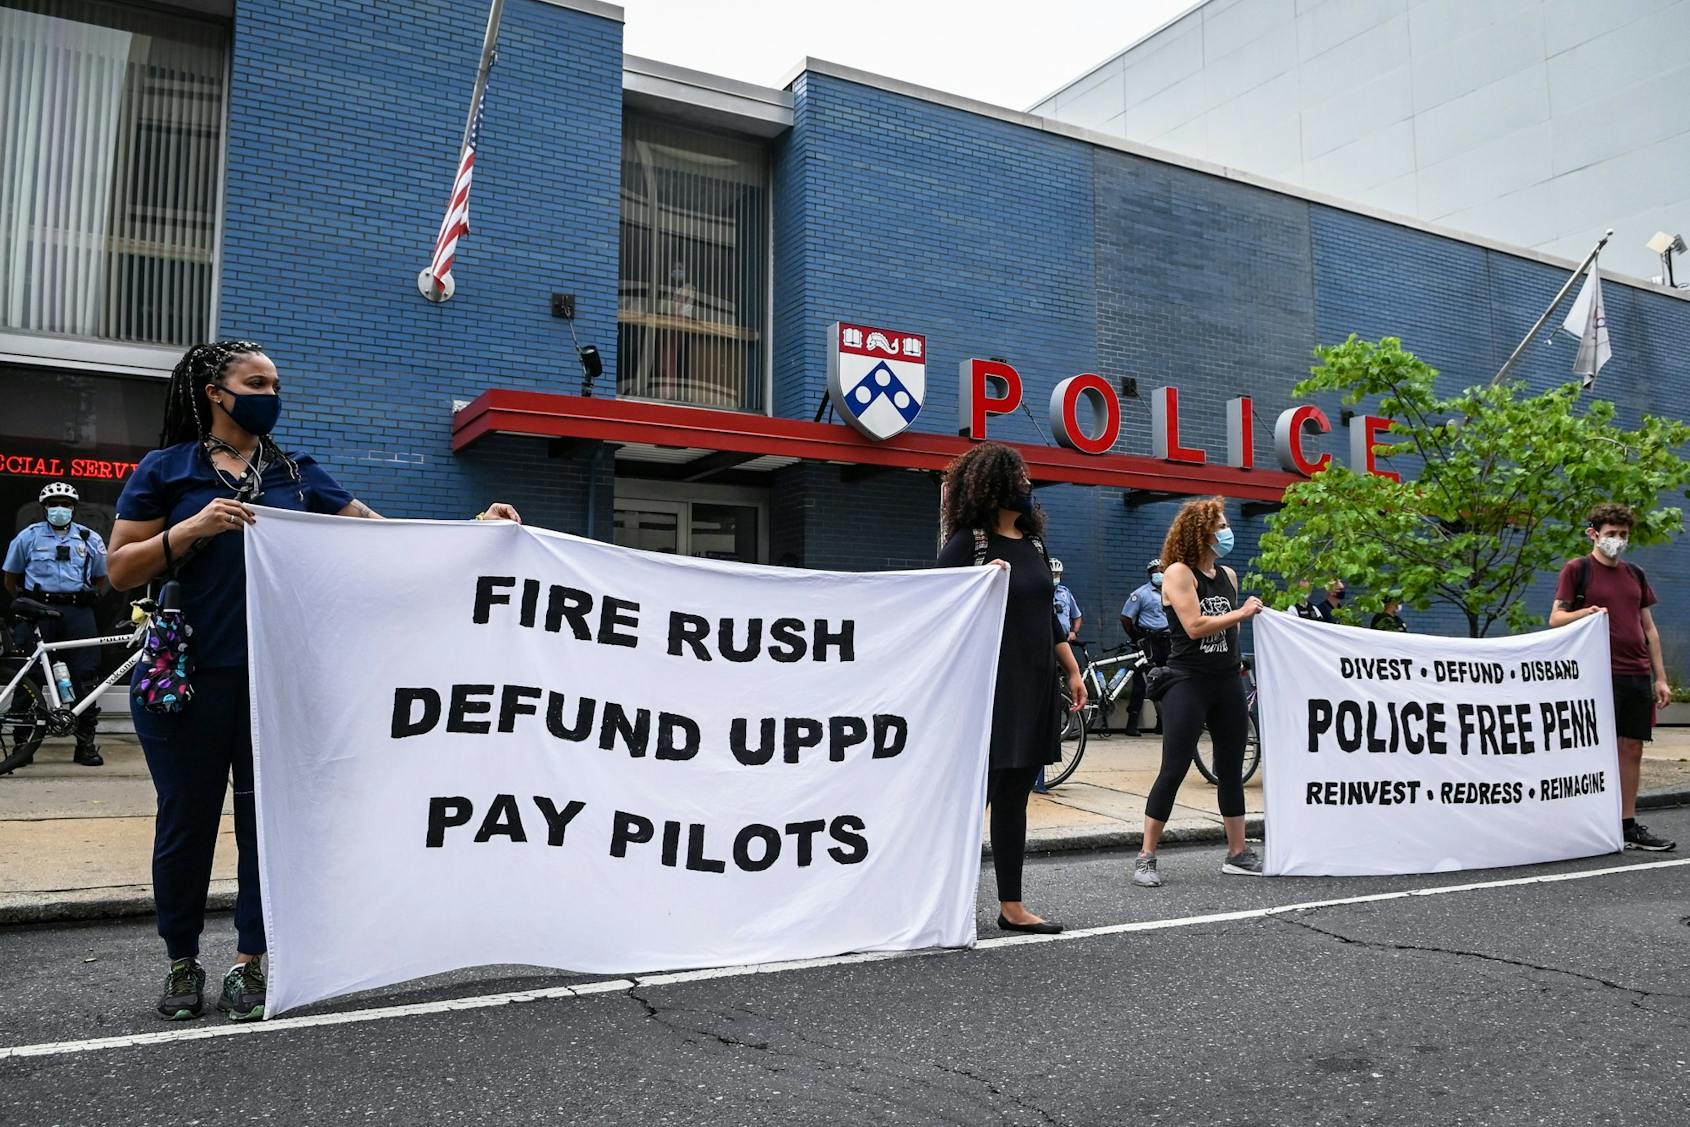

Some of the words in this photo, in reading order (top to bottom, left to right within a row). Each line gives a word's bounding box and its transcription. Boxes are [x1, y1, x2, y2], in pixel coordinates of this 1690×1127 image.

[960, 358, 1401, 484] POLICE
[473, 576, 639, 648] FIRE
[667, 611, 854, 662] RUSH
[1341, 657, 1412, 681] DIVEST
[1433, 661, 1505, 684] DEFUND
[1520, 659, 1579, 682] DISBAND
[391, 684, 700, 762] DEFUND
[730, 713, 907, 767] UPPD
[1308, 698, 1447, 754] POLICE
[1457, 703, 1535, 756] FREE
[1538, 699, 1599, 752] PENN
[1306, 780, 1421, 806] REINVEST
[1440, 782, 1523, 805] REDRESS
[1540, 771, 1605, 802] REIMAGINE
[426, 793, 586, 848] PAY
[610, 811, 868, 874] PILOTS
